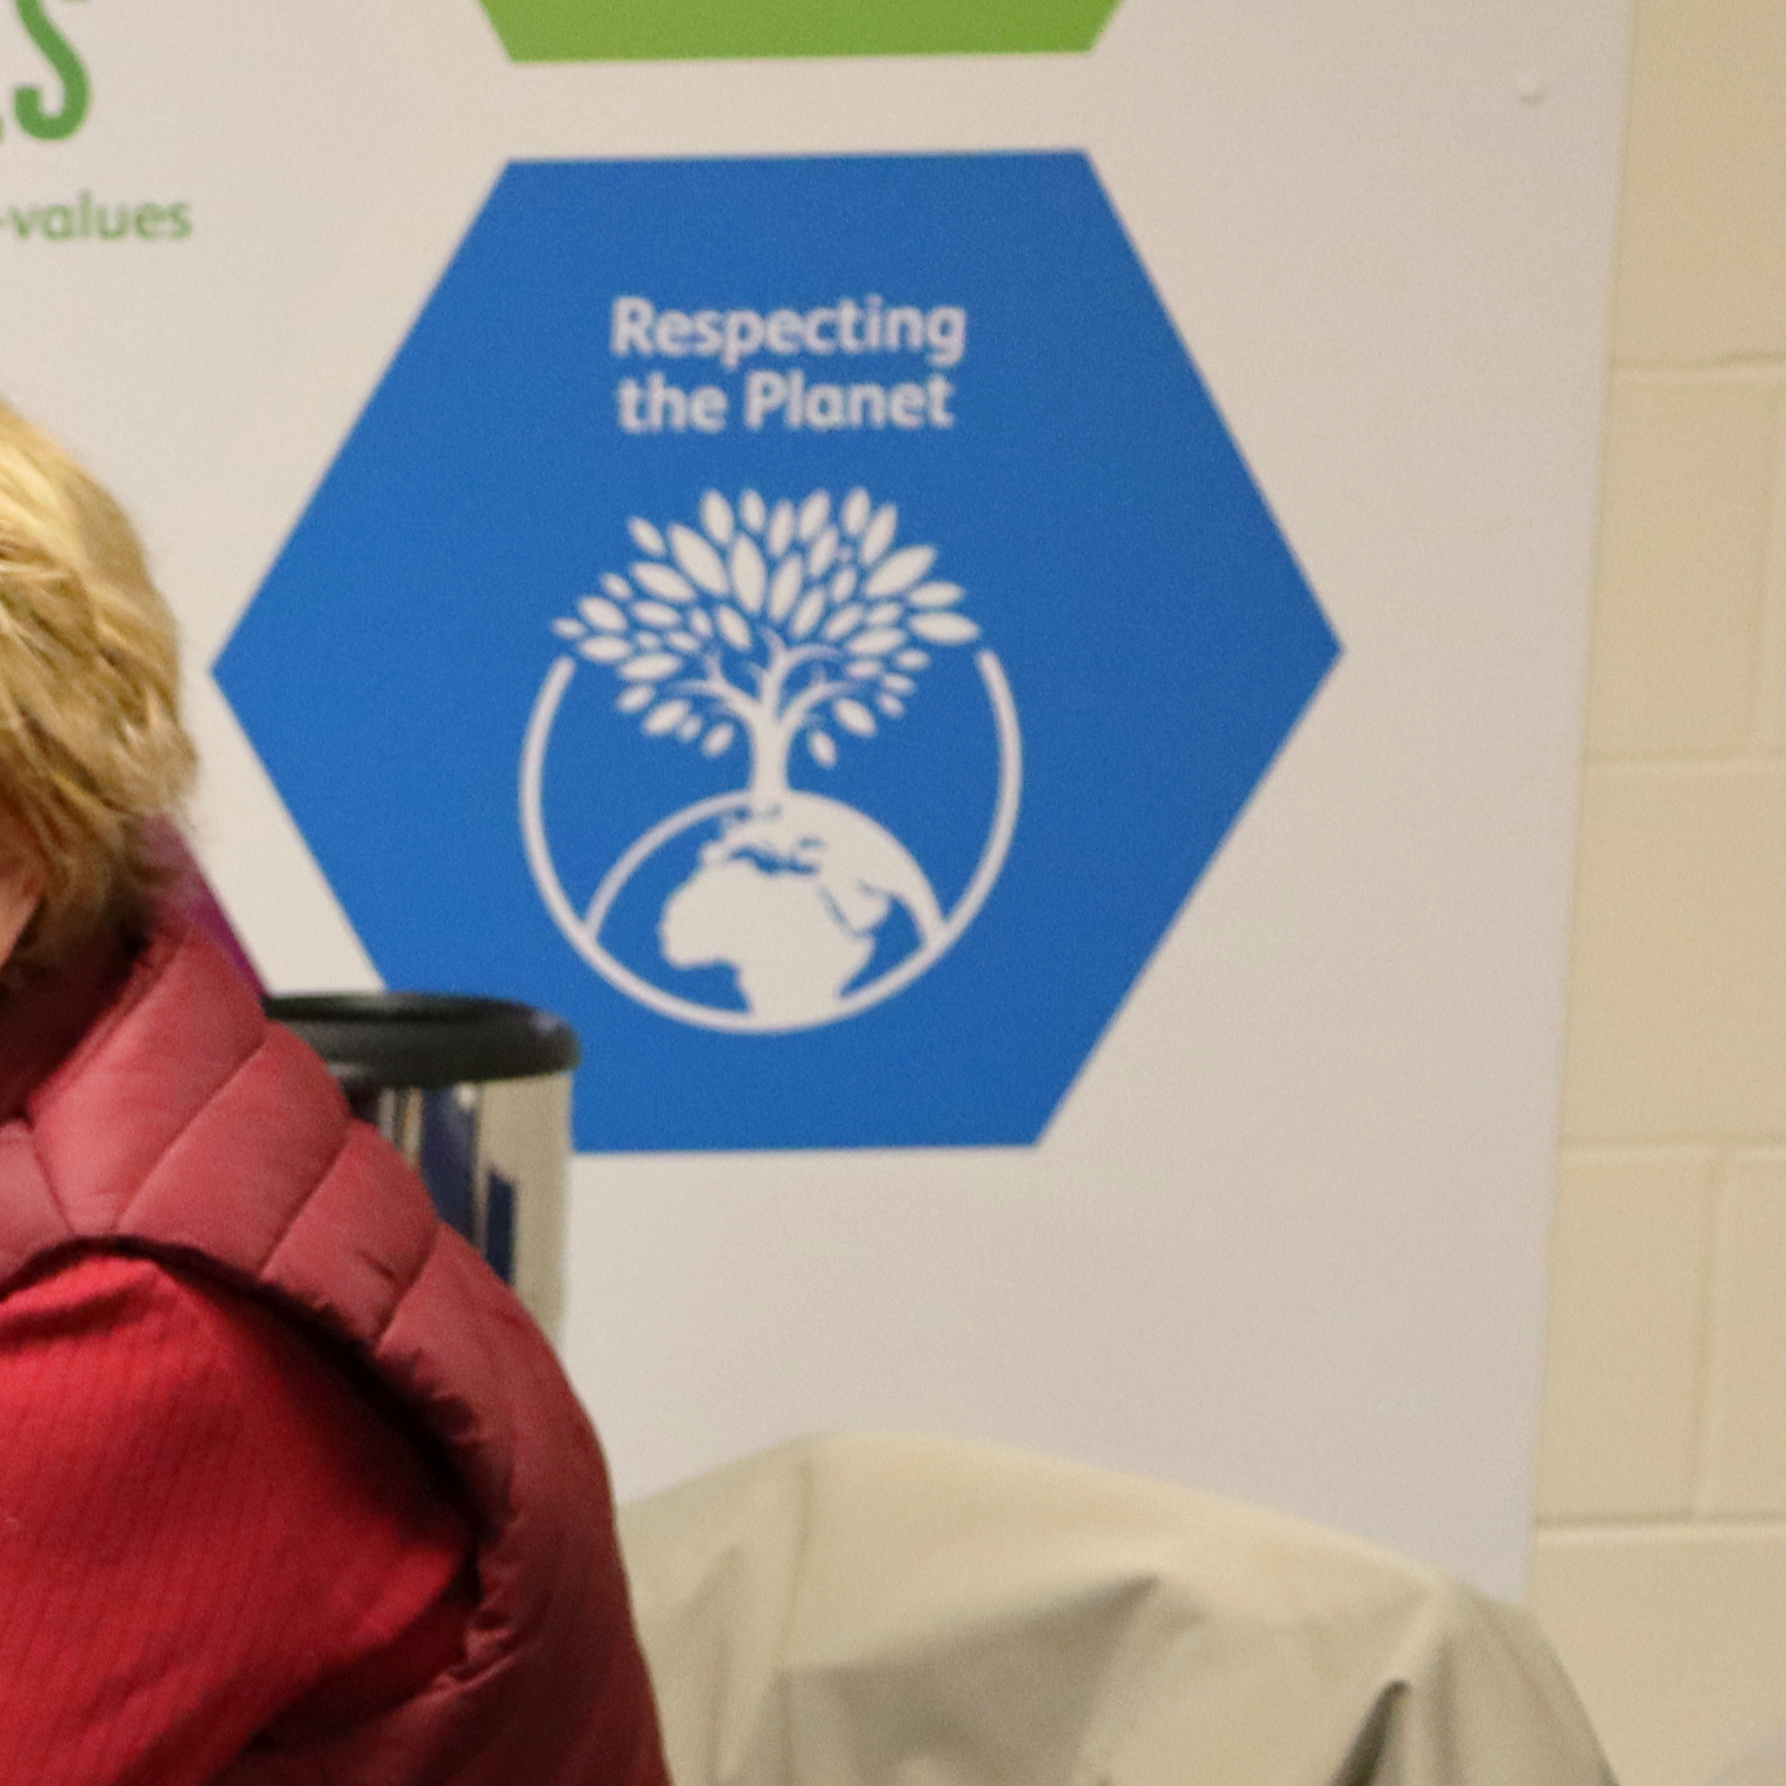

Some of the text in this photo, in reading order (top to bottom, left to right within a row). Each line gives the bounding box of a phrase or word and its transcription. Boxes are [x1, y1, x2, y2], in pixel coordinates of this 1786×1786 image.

[611, 294, 967, 368] Respecting
[618, 369, 955, 433] the Planet
